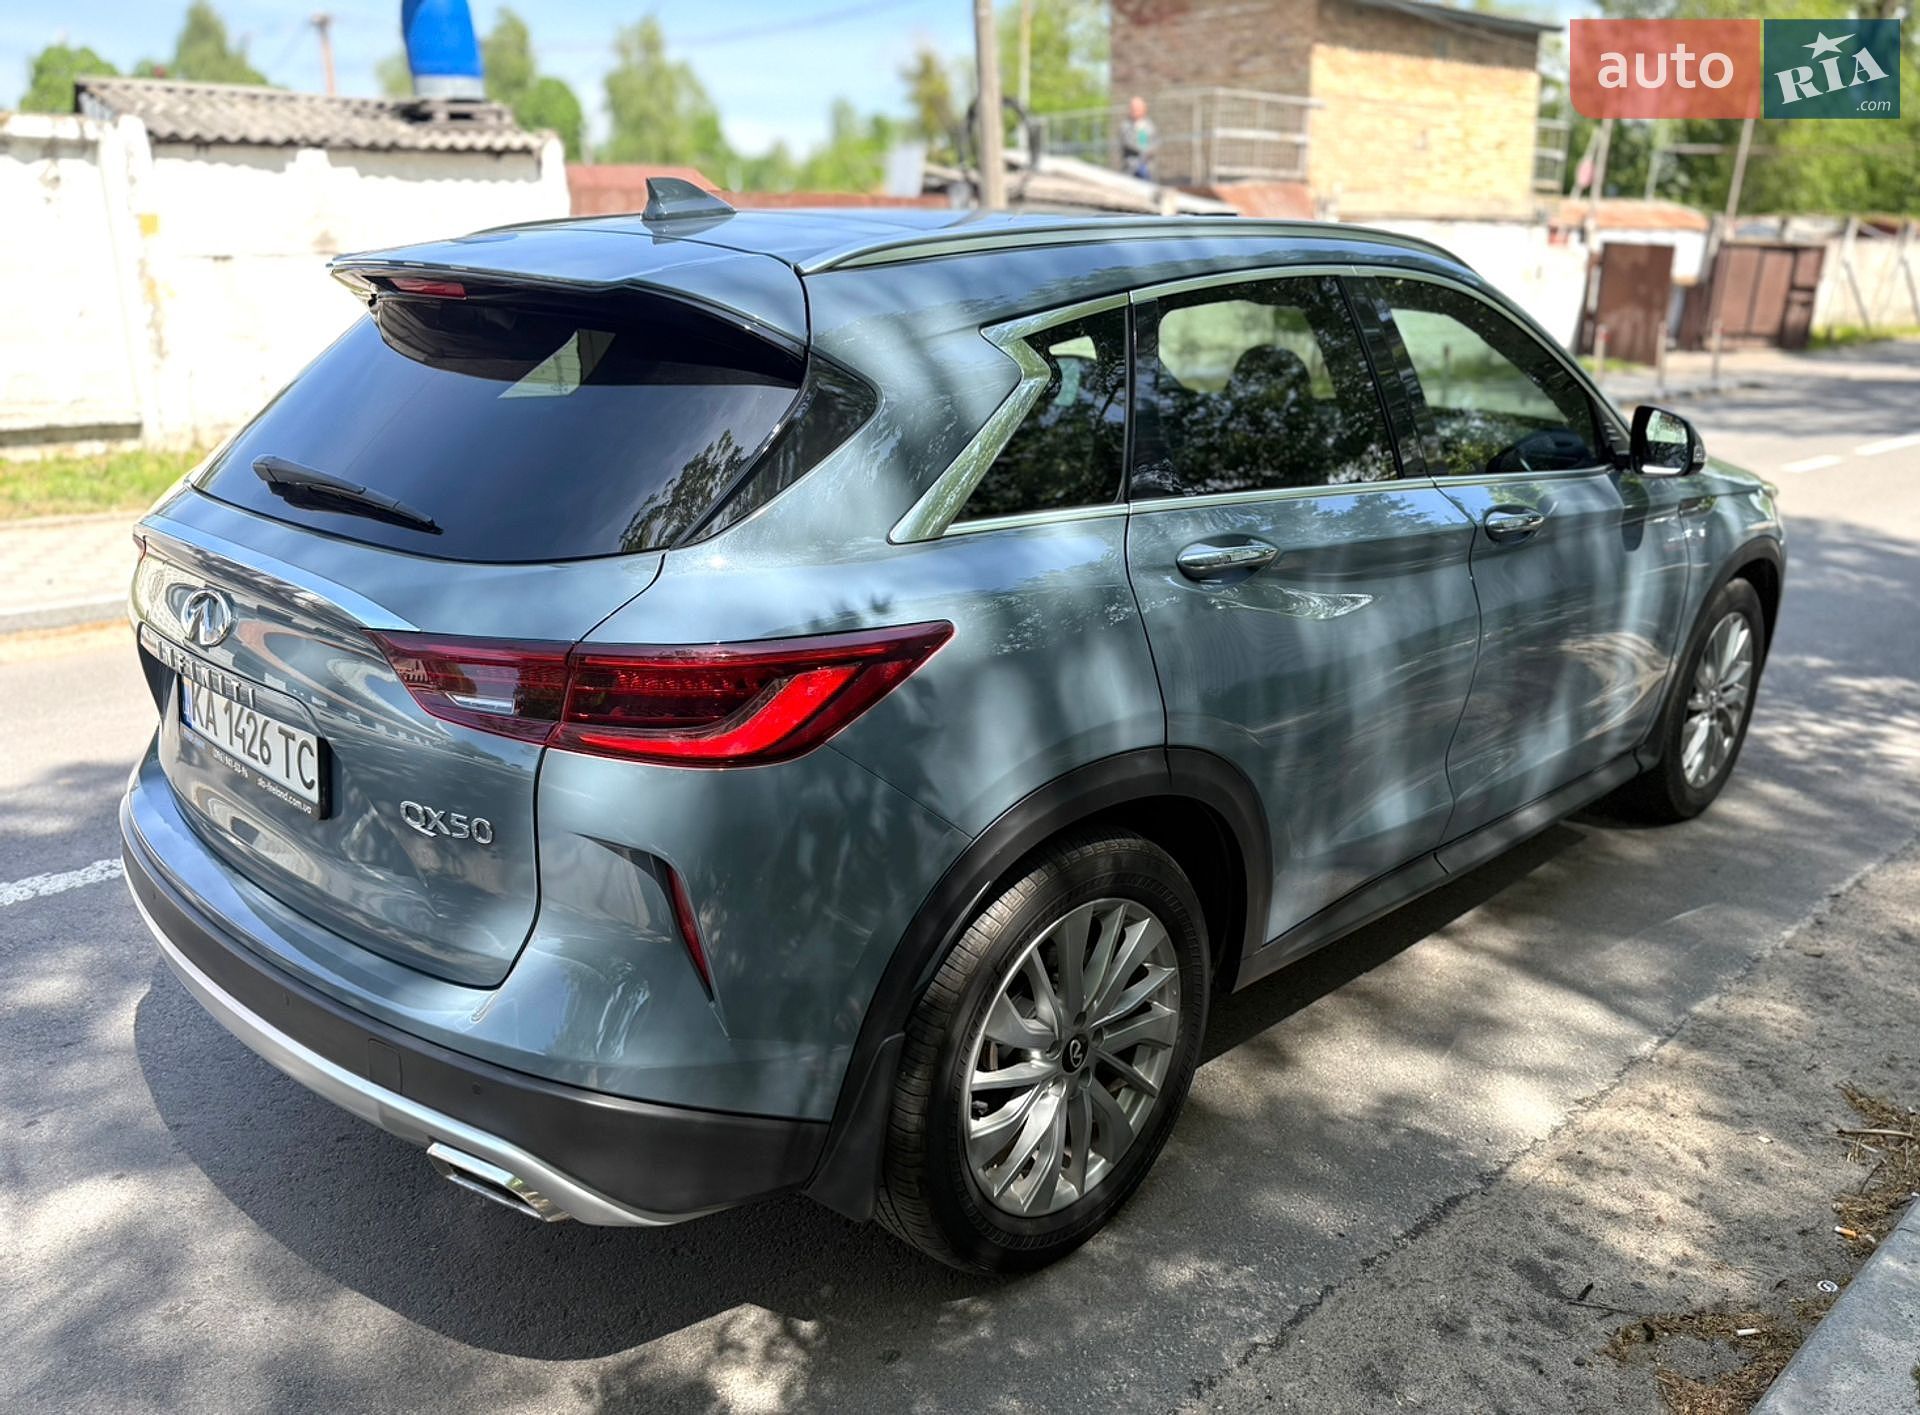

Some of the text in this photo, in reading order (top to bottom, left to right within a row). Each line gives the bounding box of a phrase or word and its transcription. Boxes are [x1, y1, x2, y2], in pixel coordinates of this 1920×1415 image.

[191, 681, 218, 737] KA
[223, 699, 272, 766] 1426
[277, 725, 316, 790] TC
[400, 800, 493, 844] QX50
